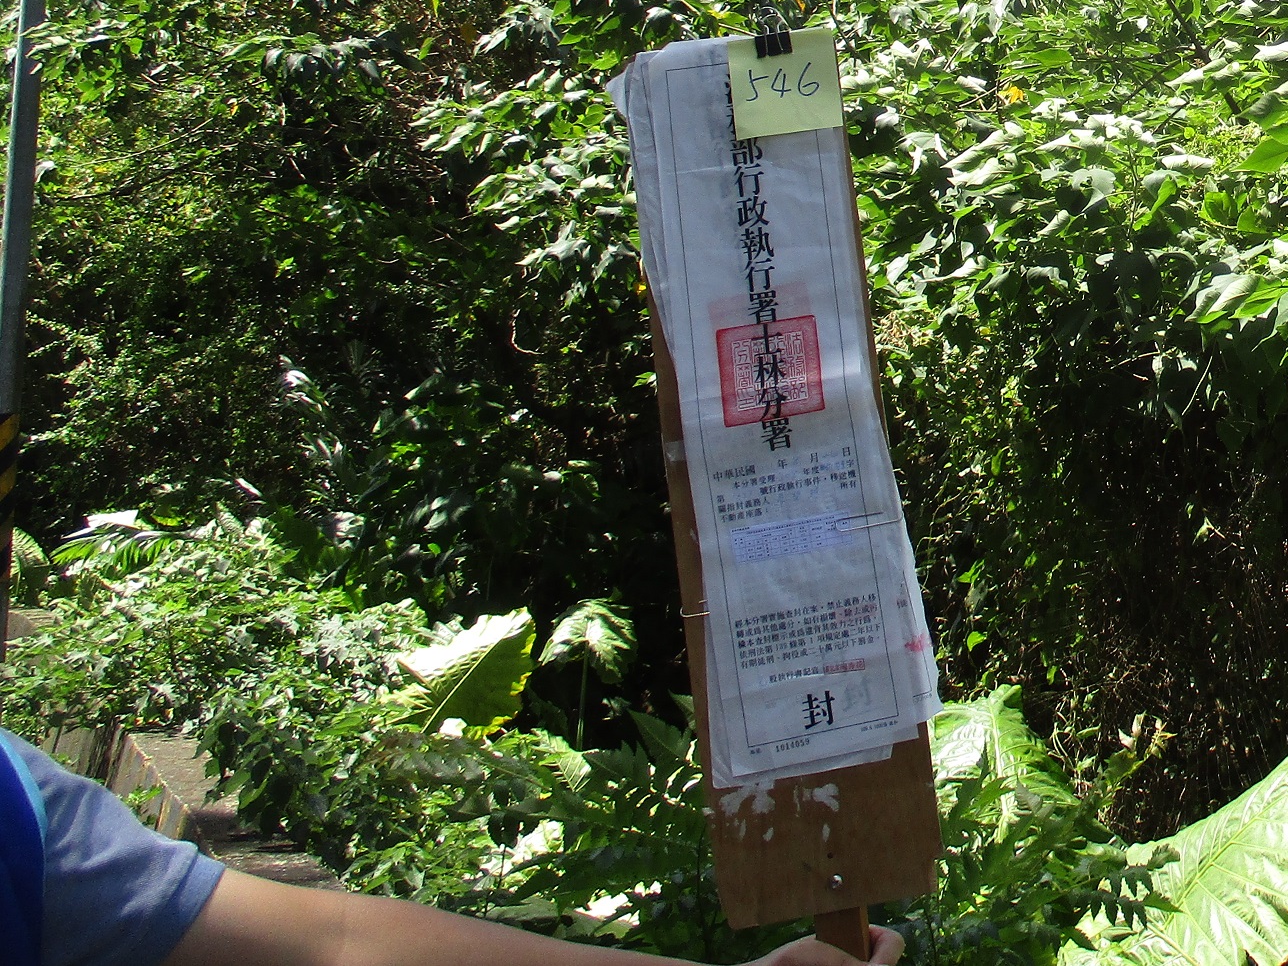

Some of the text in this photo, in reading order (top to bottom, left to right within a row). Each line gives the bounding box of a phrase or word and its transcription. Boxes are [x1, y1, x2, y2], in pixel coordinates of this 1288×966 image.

[745, 62, 820, 101] 546
[725, 73, 792, 451] 部行政執行署士林分署
[713, 447, 851, 482] 中華民國 年 月 日
[802, 690, 835, 730] 封
